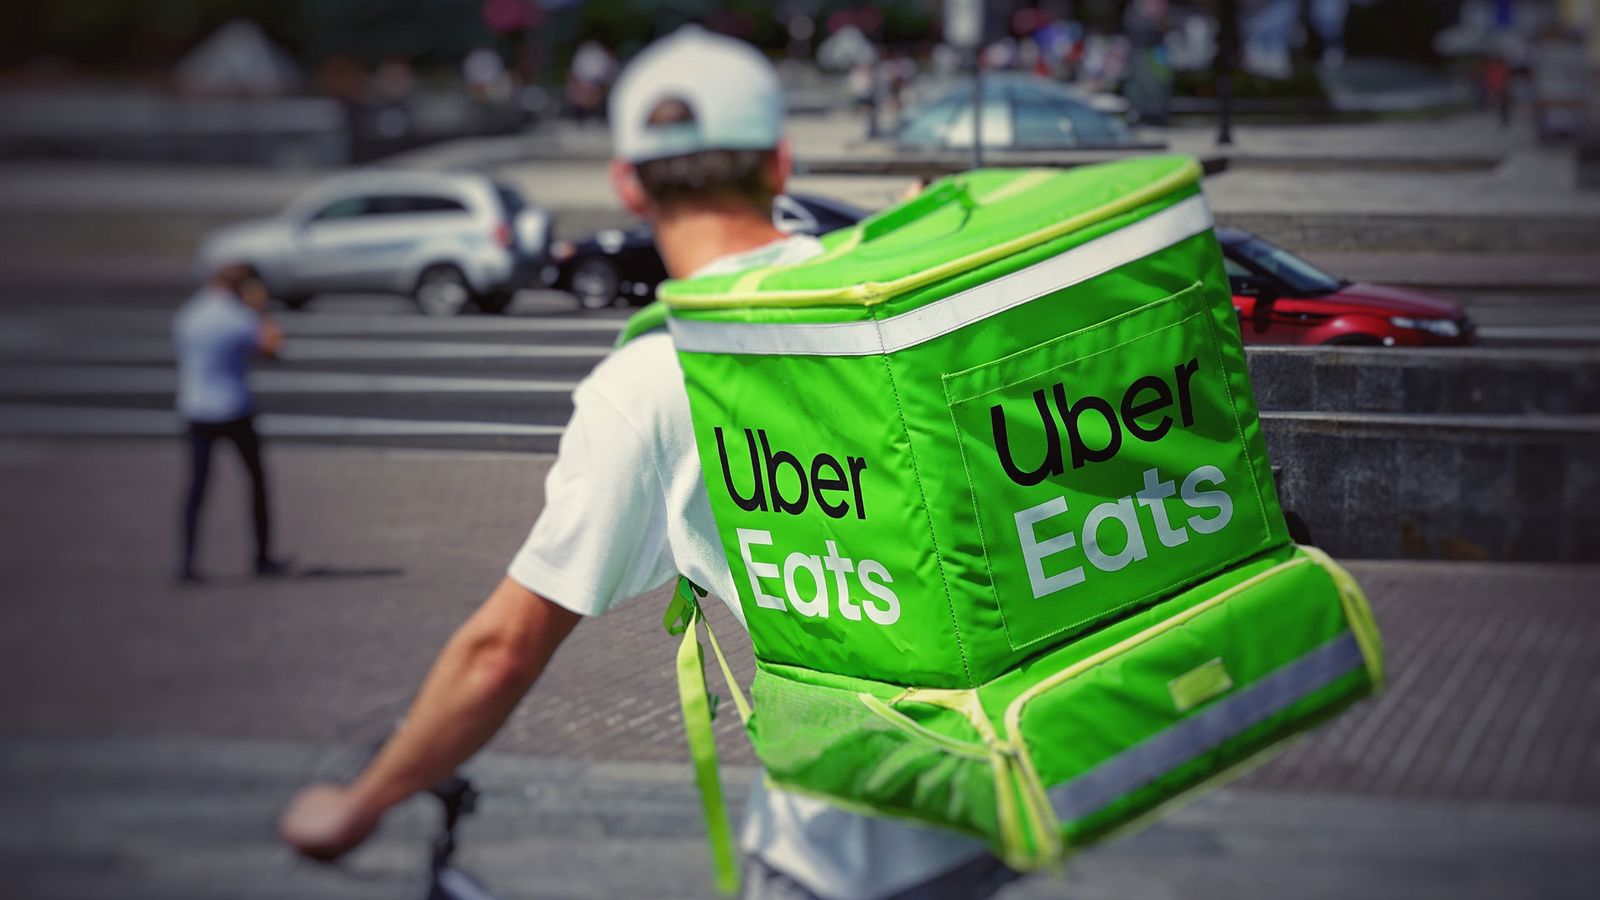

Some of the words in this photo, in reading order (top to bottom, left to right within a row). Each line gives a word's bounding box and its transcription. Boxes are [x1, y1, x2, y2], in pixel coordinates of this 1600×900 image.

[714, 427, 867, 520] Uber
[990, 358, 1199, 486] Uber
[736, 528, 900, 625] Eats
[1013, 465, 1233, 599] Eats
